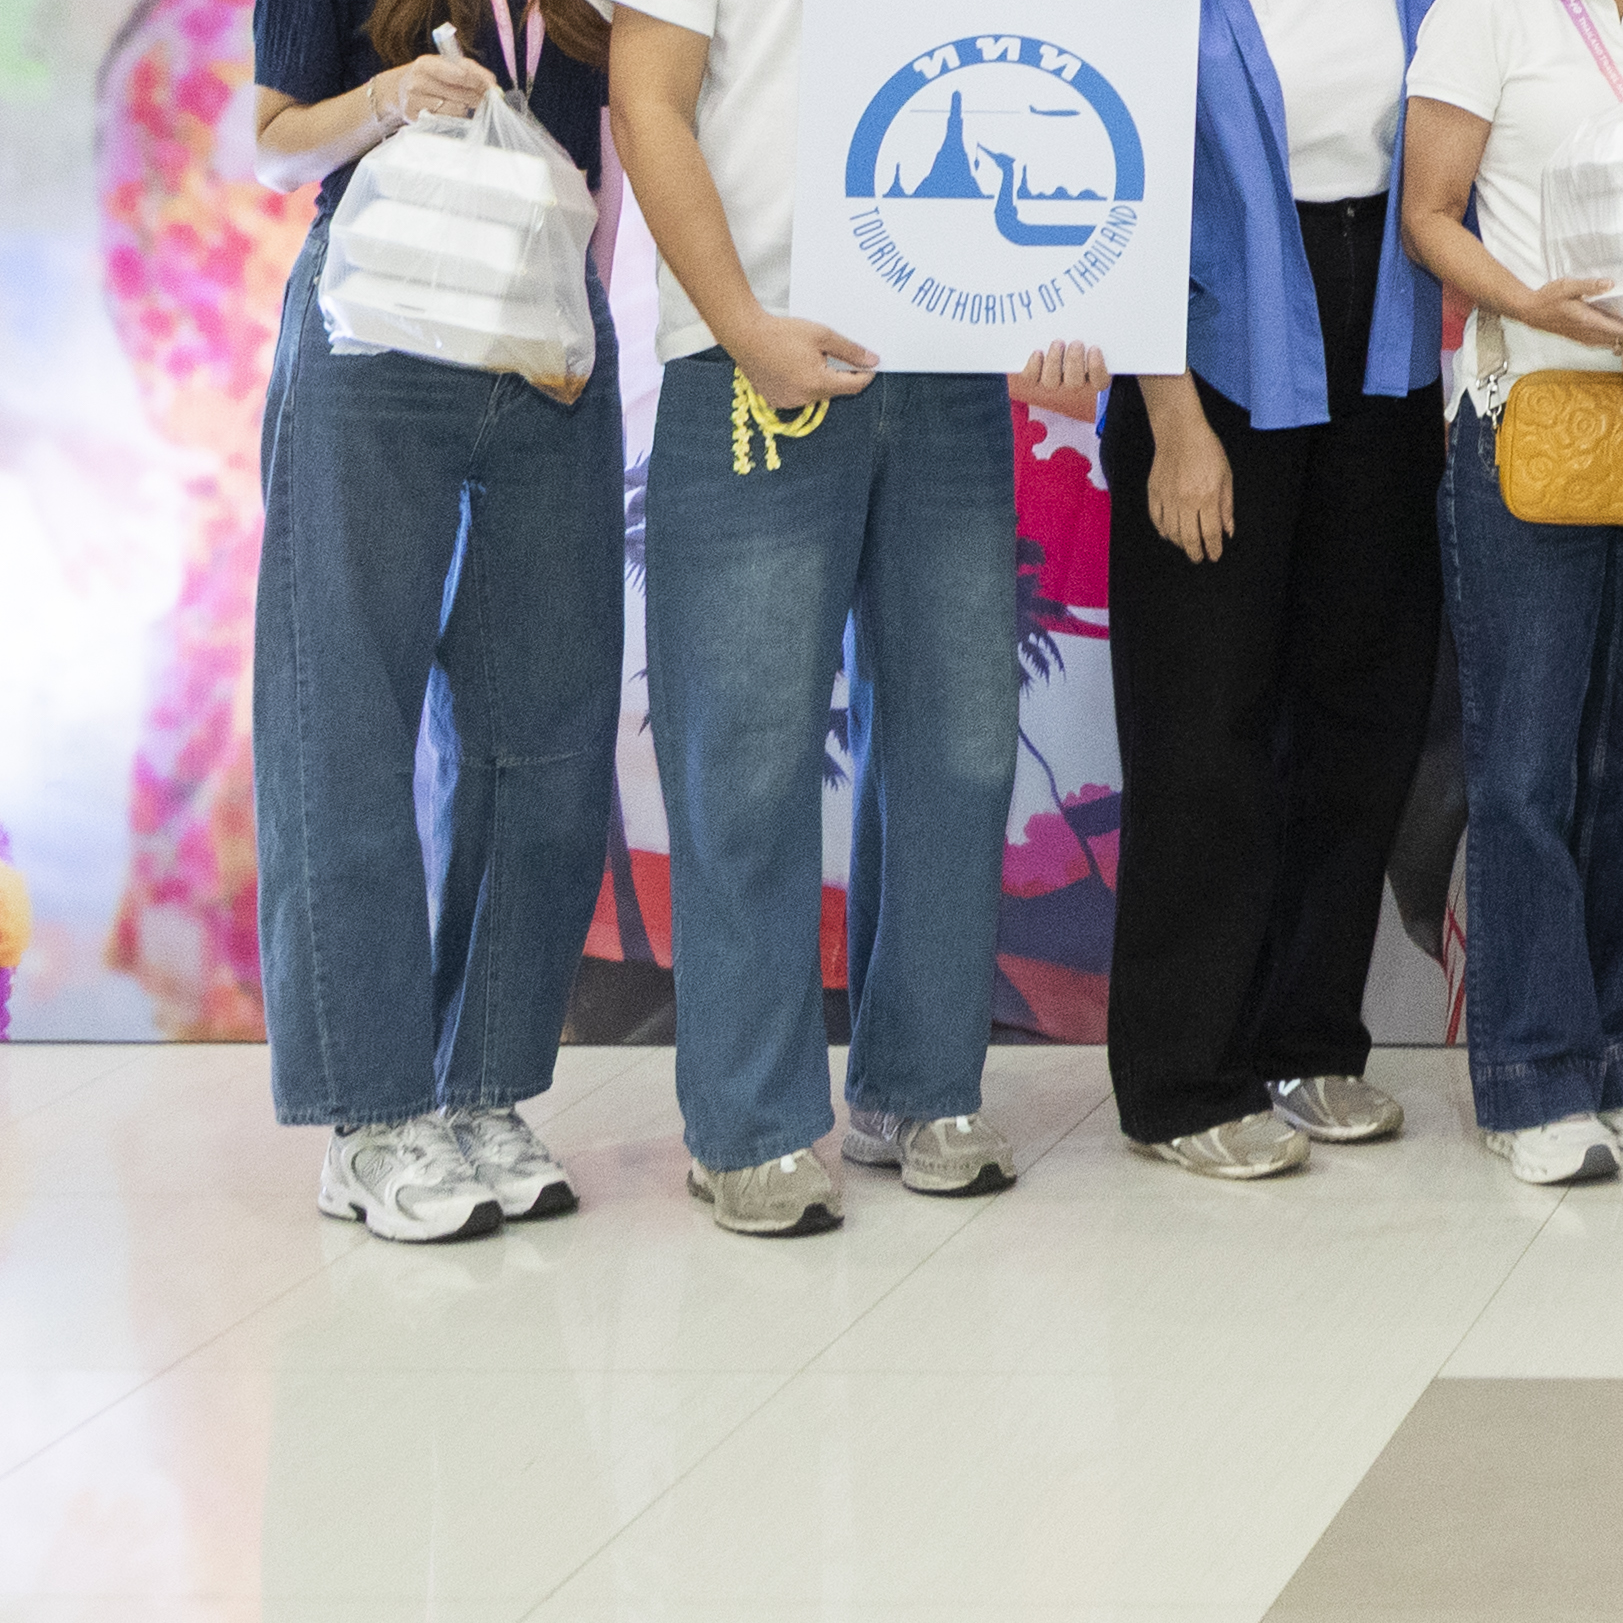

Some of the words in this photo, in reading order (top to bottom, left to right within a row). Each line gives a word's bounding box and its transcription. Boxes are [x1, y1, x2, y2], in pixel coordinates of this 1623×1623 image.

[849, 206, 916, 293] TOURISM
[911, 277, 1034, 325] AUTHORITY
[1038, 277, 1066, 313] OF
[1064, 204, 1139, 295] THAILAND
